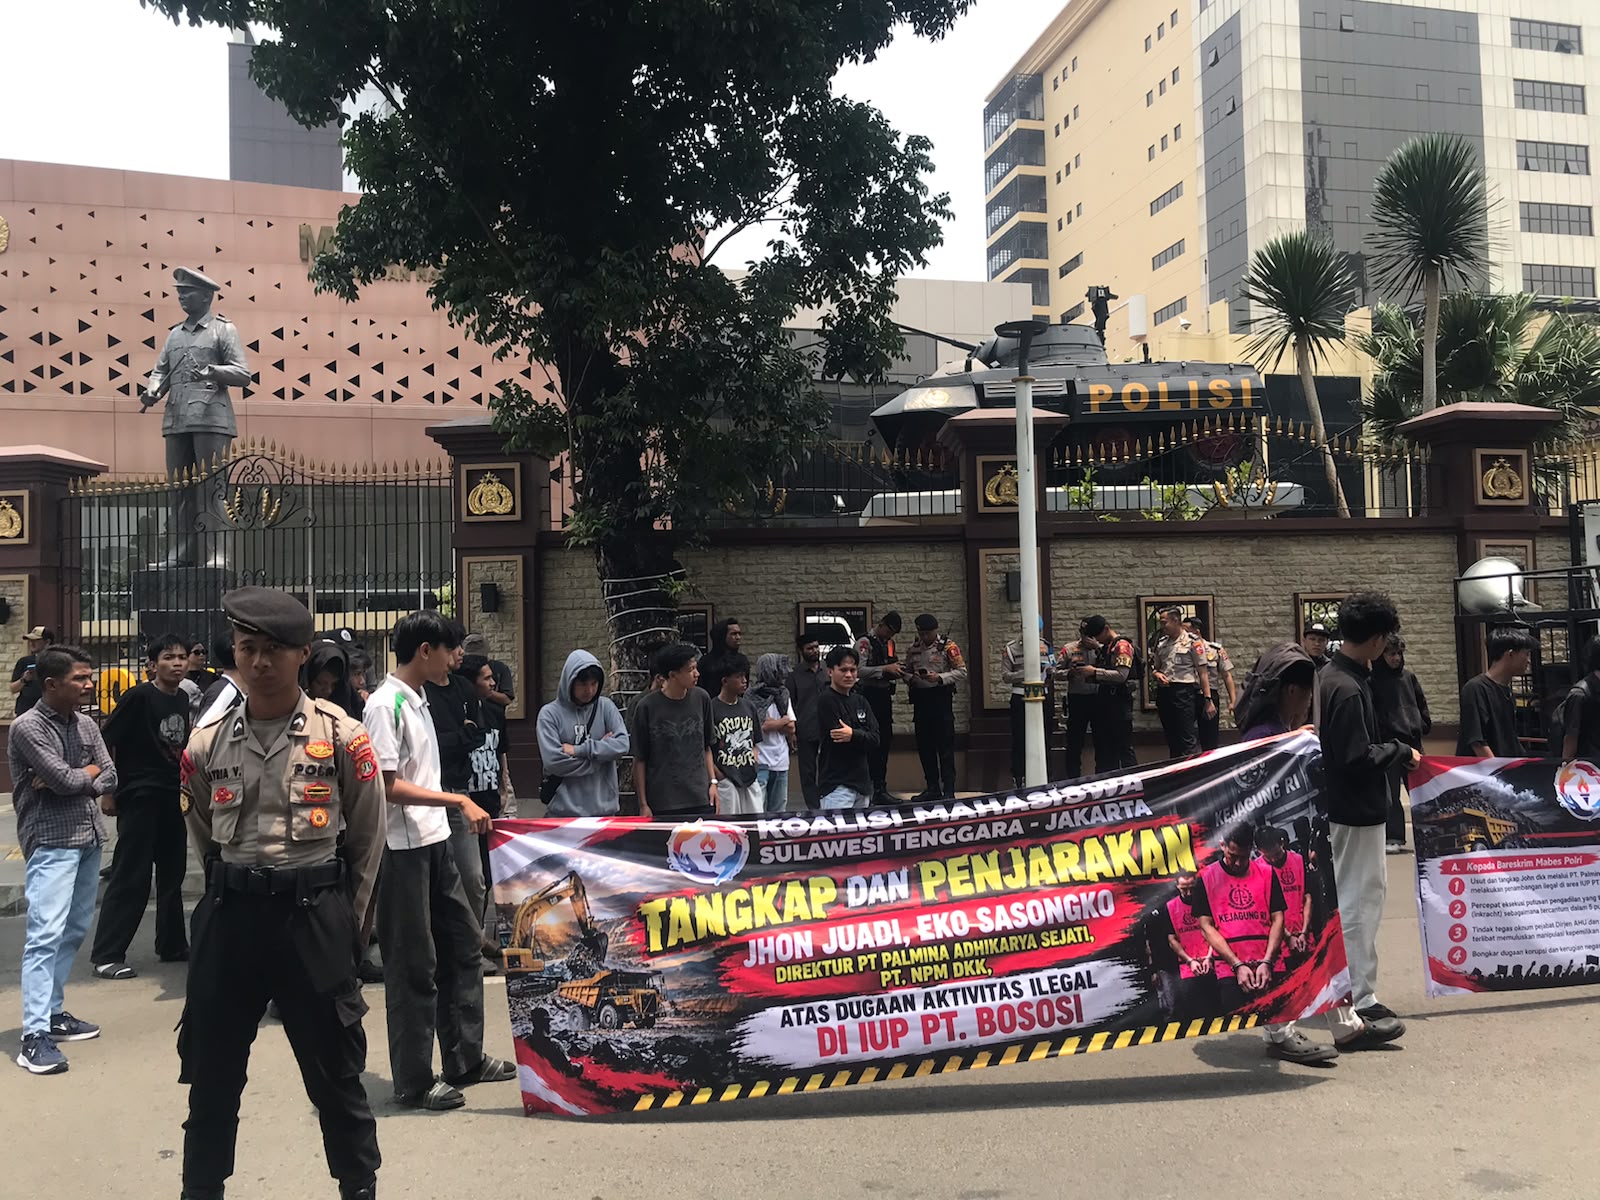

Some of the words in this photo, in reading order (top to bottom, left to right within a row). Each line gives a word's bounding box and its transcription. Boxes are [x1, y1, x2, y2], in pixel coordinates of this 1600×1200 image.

[1088, 379, 1252, 413] POLISI
[757, 809, 903, 840] KOALISI
[913, 778, 1144, 824] MAHASISWA
[1215, 783, 1281, 827] KEJAGUNG
[1284, 773, 1302, 794] RI
[760, 835, 884, 864] SULAWESI
[890, 819, 1025, 851] TENGGARA
[1045, 799, 1153, 831] JAKARTA
[639, 876, 837, 952] TANGKAP
[846, 867, 909, 907] DAN
[917, 823, 1198, 901] PENJARAKAN
[1451, 862, 1461, 872] A.
[1466, 861, 1495, 873] Kepada
[1497, 858, 1534, 869] Bareskrim
[1535, 857, 1562, 867] Mabes
[1564, 855, 1583, 865] Polri
[743, 930, 814, 967] JHON
[822, 919, 911, 954] JUADI,
[916, 910, 969, 941] EKO
[975, 889, 1115, 933] SASONGKO
[1218, 912, 1259, 923] KEJAGUNG
[775, 958, 853, 983] DIREKTUR
[858, 954, 877, 972] PT
[881, 945, 949, 969] PALMINA
[953, 933, 1037, 958] ADHIKARYA
[1040, 926, 1095, 948] SEJATI,
[881, 970, 907, 987] PT.
[911, 963, 948, 983] NPM
[953, 958, 993, 978] DKK,
[780, 1005, 830, 1028] ATAS
[835, 993, 916, 1021] DUGAAN
[923, 980, 1024, 1010] AKTIVITAS
[1029, 970, 1098, 997] ILEGAL
[817, 1024, 848, 1057] DI
[858, 1018, 909, 1052] IUP
[921, 1011, 966, 1045] PT.
[975, 994, 1084, 1037] BOSOSI
